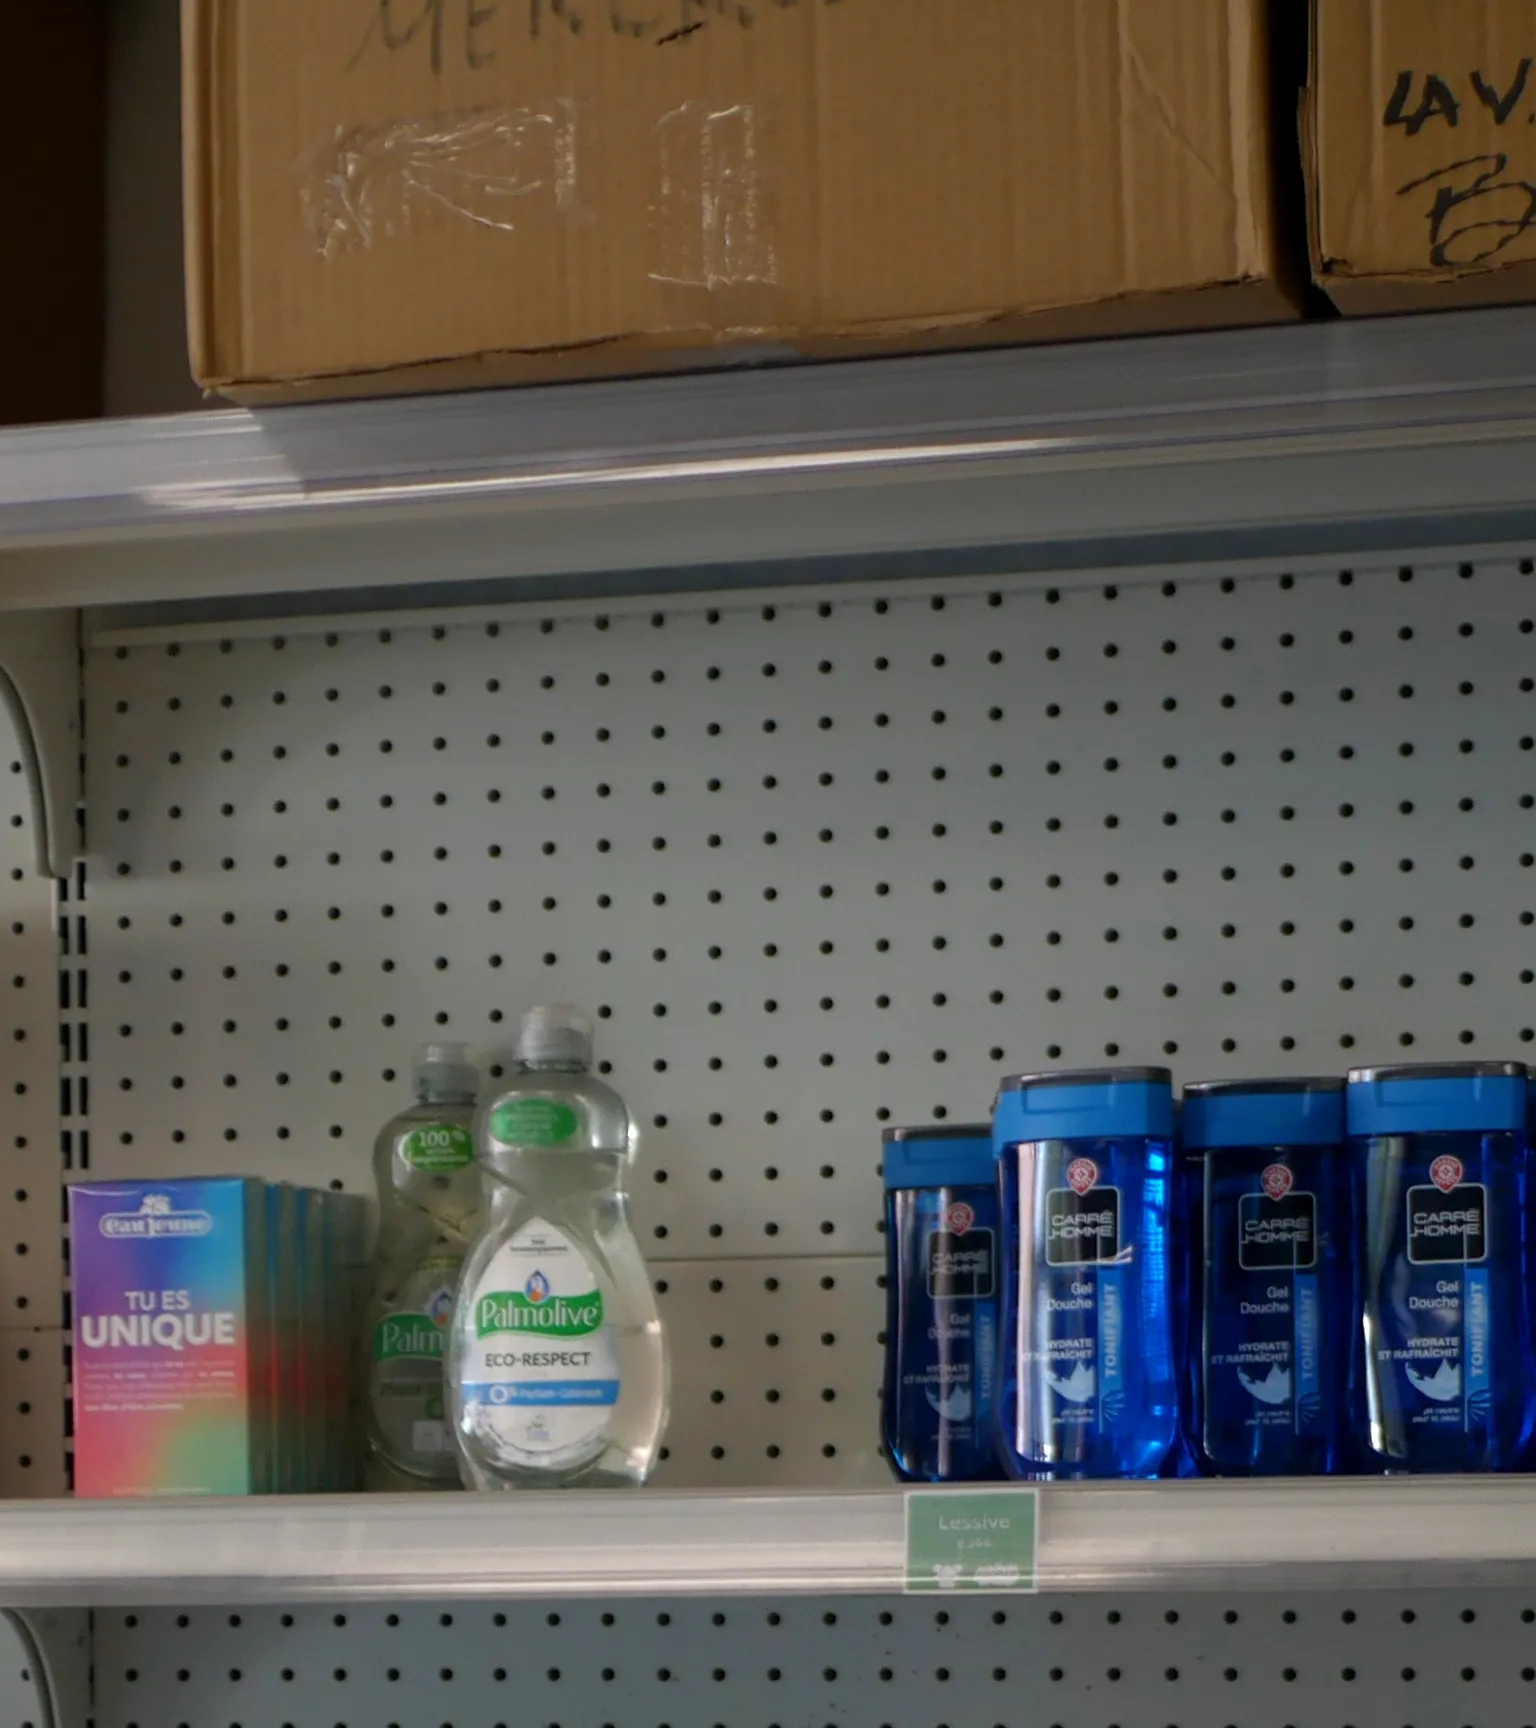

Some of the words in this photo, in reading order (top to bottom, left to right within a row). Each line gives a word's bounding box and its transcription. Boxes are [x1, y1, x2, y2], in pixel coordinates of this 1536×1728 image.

[1052, 1210, 1113, 1227] CARRÉ
[1413, 1209, 1479, 1224] CARRÉ
[1245, 1217, 1310, 1232] CARRÉ
[1410, 1223, 1479, 1237] HOMME
[1049, 1226, 1113, 1239] HOMME
[1242, 1231, 1310, 1244] HOMME
[1071, 1282, 1093, 1295] Gel
[1266, 1286, 1289, 1299] Gel
[1435, 1280, 1460, 1294] Gel
[124, 1291, 157, 1311] TU
[162, 1290, 191, 1311] ES
[1047, 1298, 1093, 1310] Douche
[1240, 1301, 1289, 1314] Douche
[1408, 1296, 1460, 1310] Douche
[482, 1299, 599, 1328] Palmolive
[81, 1312, 236, 1351] UNIQUE
[1104, 1284, 1117, 1377] TONIFIANT
[1470, 1281, 1484, 1377] TONIFIANT
[1238, 1341, 1289, 1352] HYDRATE
[1407, 1337, 1460, 1348] HYDRATE
[485, 1352, 591, 1367] ECO-RESPECT
[1393, 1348, 1460, 1360] RAFRAÎCHIT
[938, 1513, 1011, 1531] Lessive
